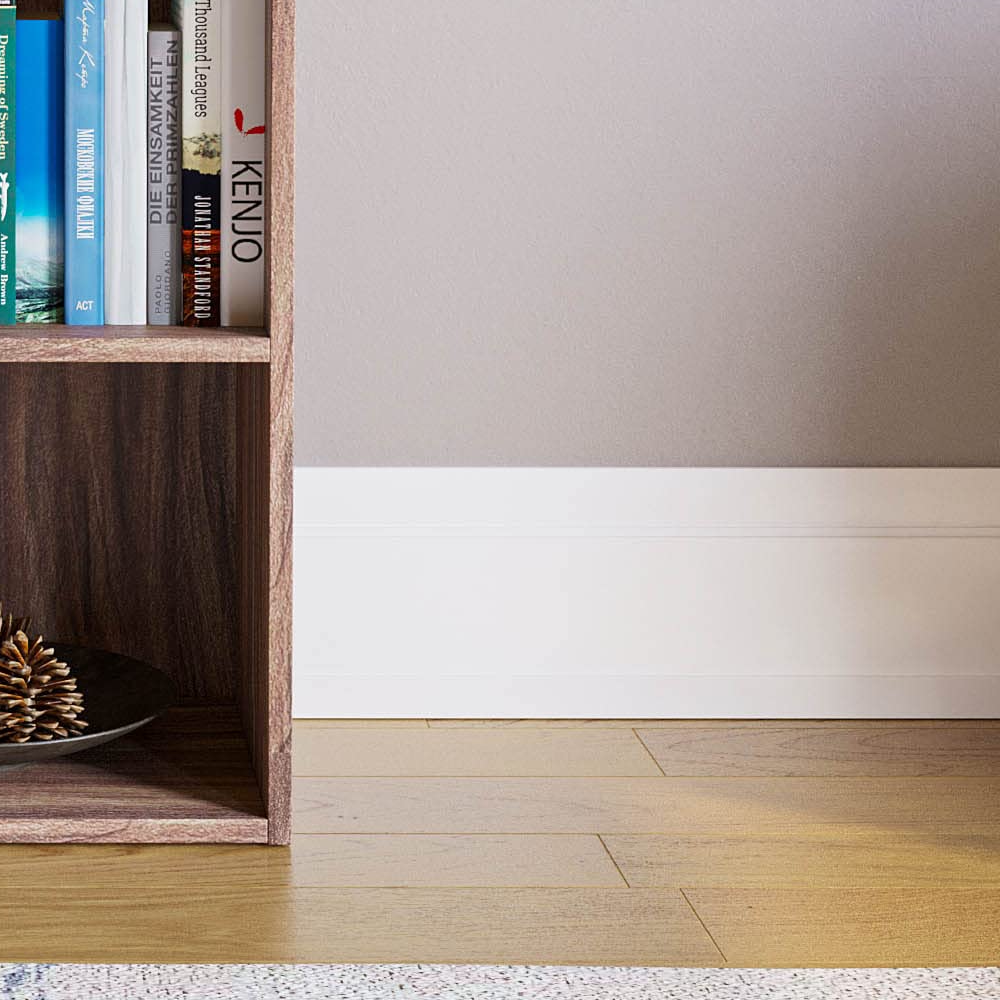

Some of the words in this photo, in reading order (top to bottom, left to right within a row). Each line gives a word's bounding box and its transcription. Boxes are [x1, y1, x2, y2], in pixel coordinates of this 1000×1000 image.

[194, 0, 212, 62] Thousand
[166, 40, 179, 175] PRIMZAHLEN
[190, 65, 211, 118] Leagues
[150, 57, 163, 184] EINSAMKEIT
[76, 128, 95, 193] МОСКОВСКИЕ
[76, 195, 95, 240] ФИАЛКИ
[150, 191, 163, 224] DIE
[166, 182, 178, 224] DER
[194, 195, 211, 251] JONATHAN
[231, 160, 263, 263] KENJO
[0, 233, 9, 272] Andrew
[0, 274, 9, 306] Brown
[194, 256, 211, 319] STANDFORD
